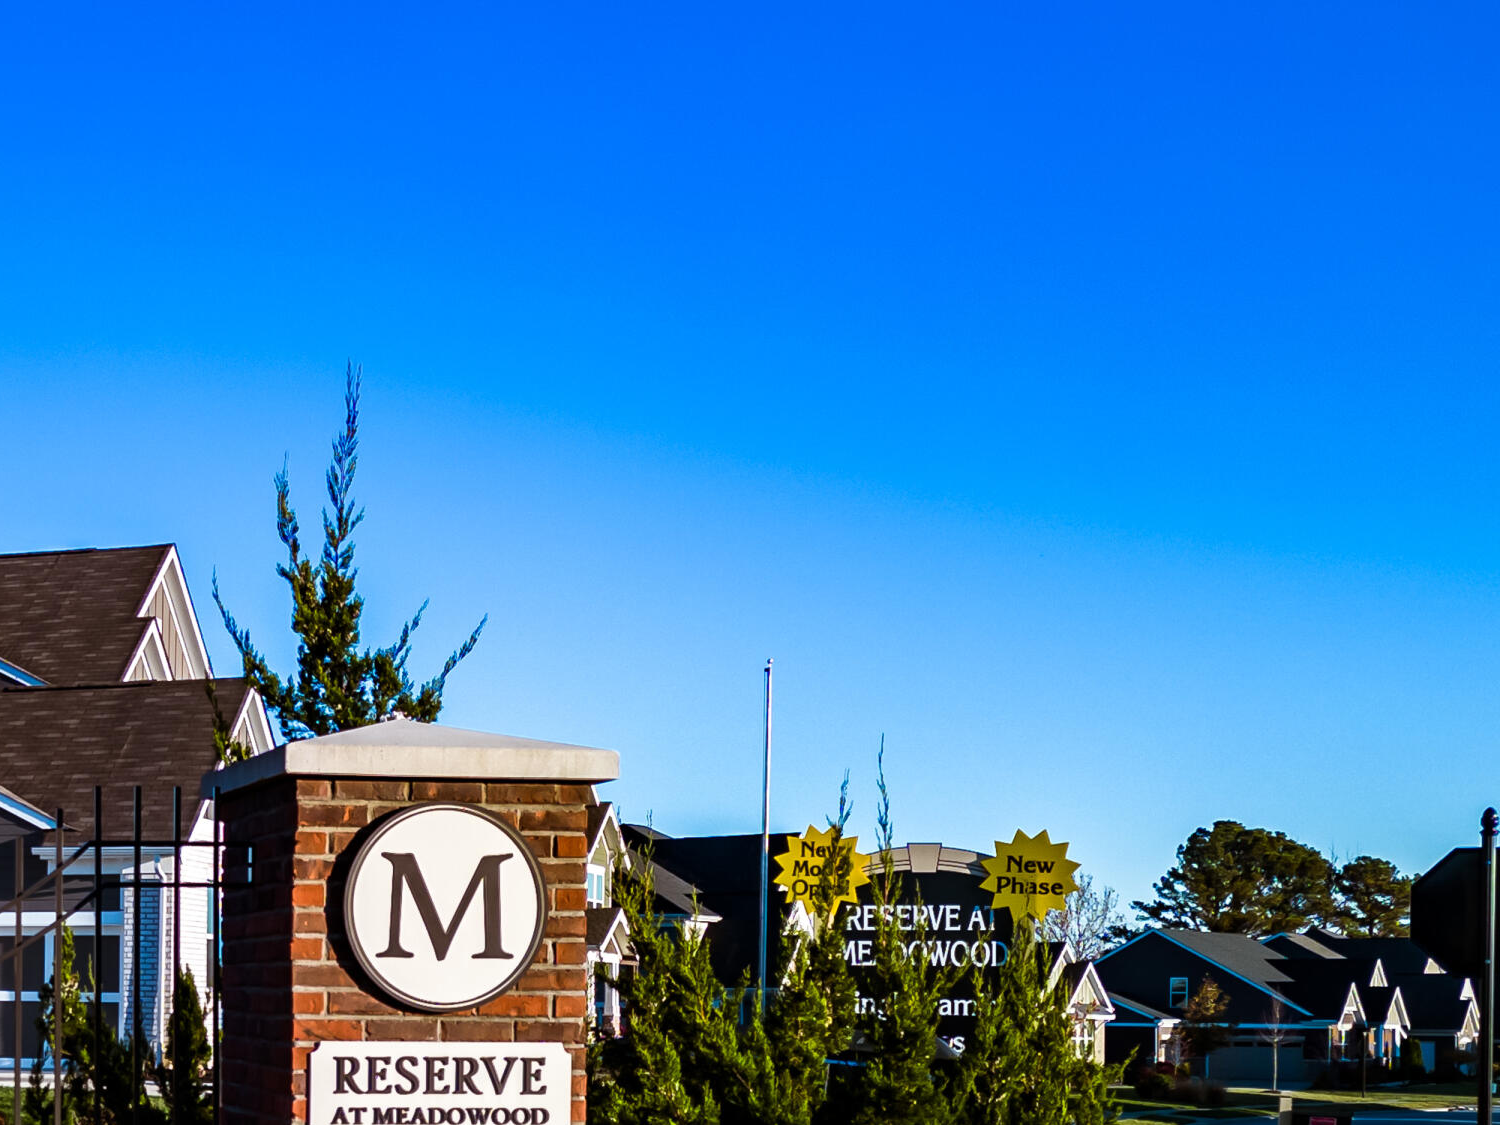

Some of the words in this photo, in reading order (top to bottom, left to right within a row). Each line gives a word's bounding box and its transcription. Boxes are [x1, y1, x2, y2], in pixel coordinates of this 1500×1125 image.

[1006, 855, 1055, 873] New
[996, 876, 1064, 895] Phase
[375, 851, 514, 961] M
[845, 904, 961, 931] RESERVE
[332, 1056, 548, 1095] RESERVE
[330, 1107, 367, 1125] AT
[372, 1107, 550, 1125] MEADOWOOD
